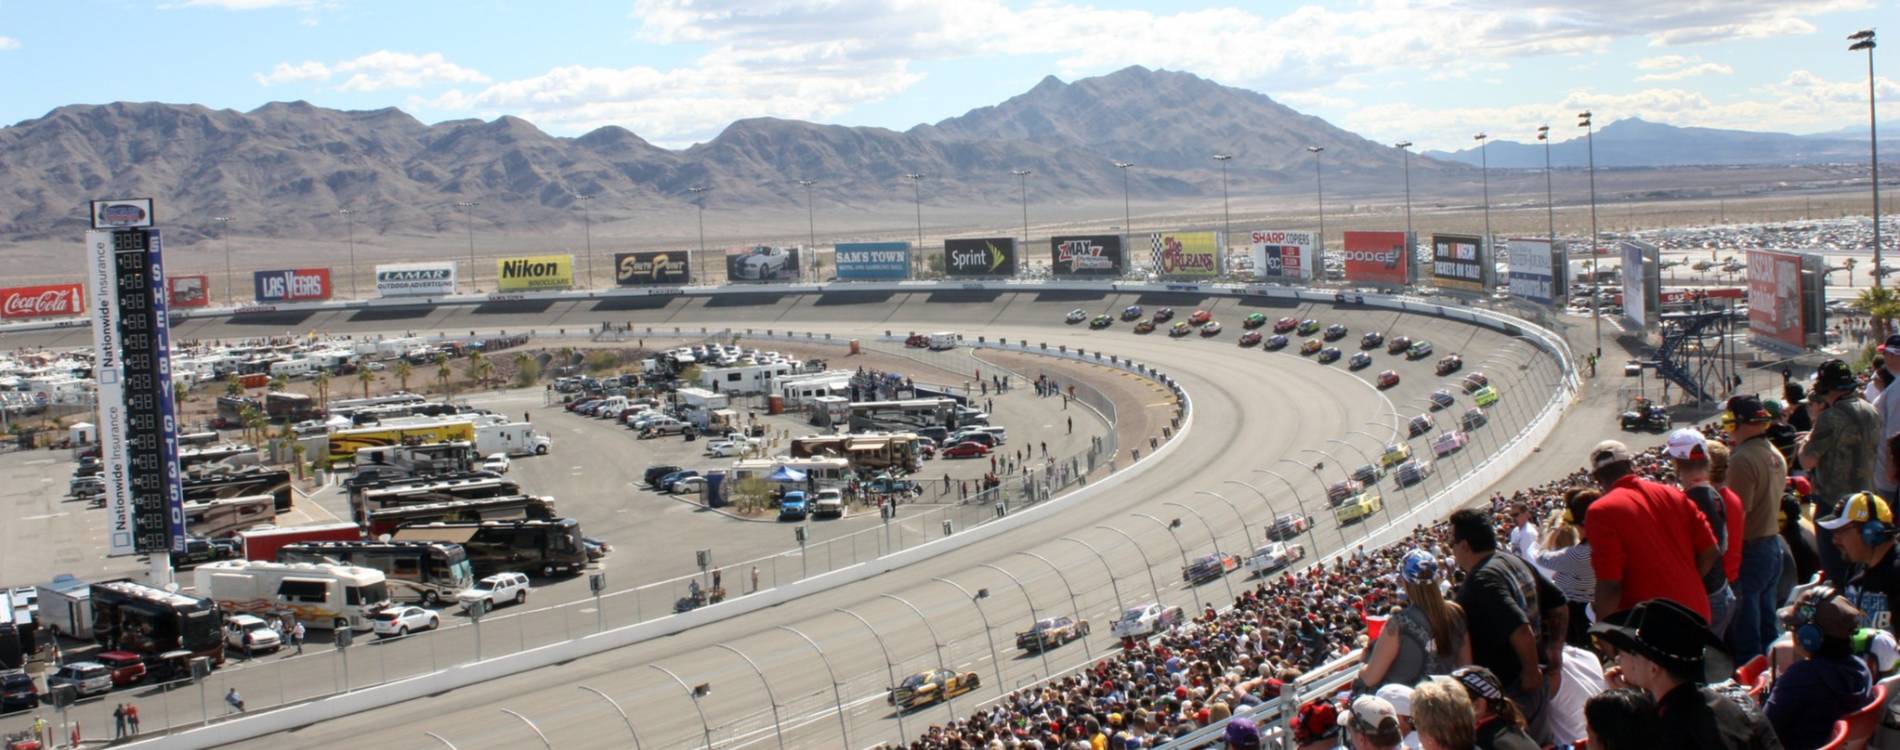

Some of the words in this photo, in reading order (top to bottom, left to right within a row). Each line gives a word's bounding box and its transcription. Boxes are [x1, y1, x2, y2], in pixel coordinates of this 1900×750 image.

[1252, 232, 1284, 244] SHARP
[836, 252, 869, 263] SAM'S
[871, 251, 905, 263] TOWN
[952, 249, 986, 270] Sprint
[1345, 250, 1395, 263] DODGE
[96, 241, 108, 297] Insurance
[384, 270, 445, 280] LAMAR
[502, 260, 558, 278] Nikon
[263, 277, 284, 297] LAS
[284, 271, 321, 299] VEGAS
[101, 299, 113, 368] Nationwide
[109, 406, 122, 462] Insurance
[112, 463, 126, 531] Nationwide
